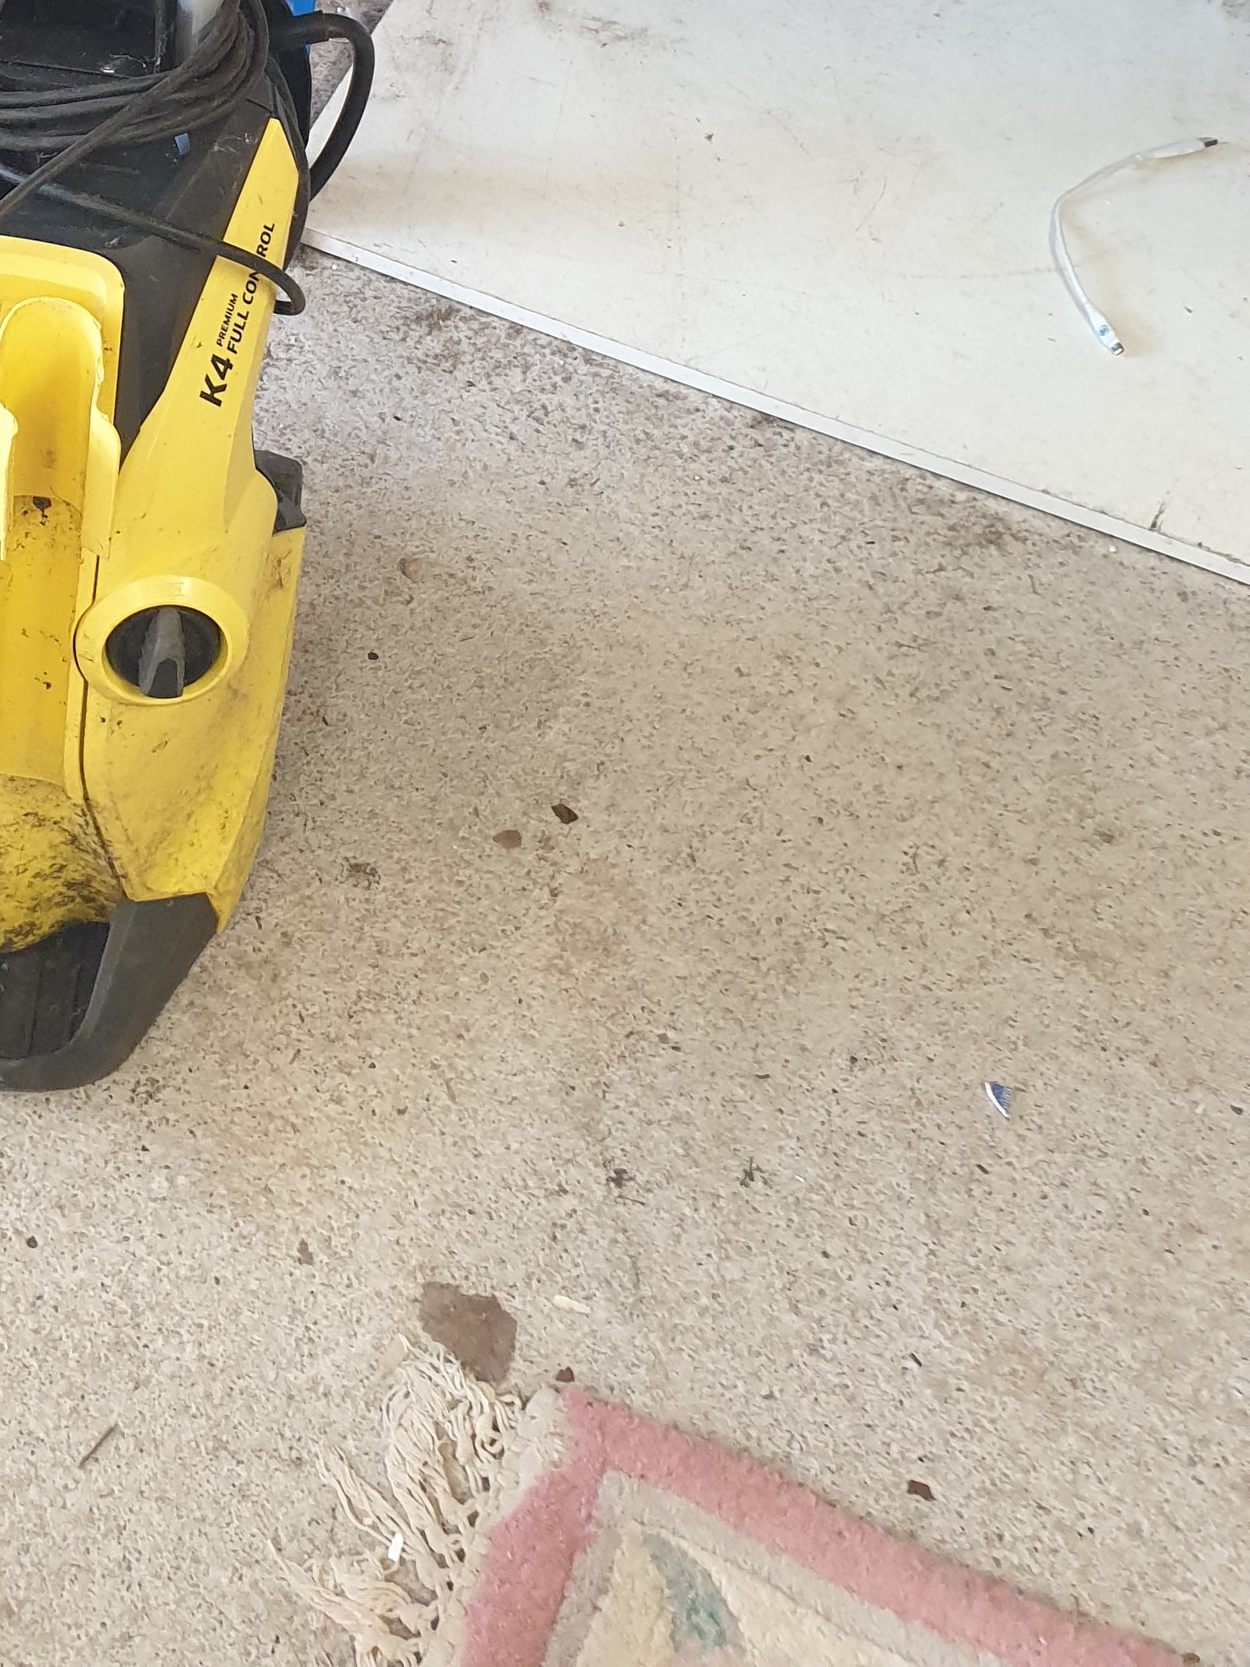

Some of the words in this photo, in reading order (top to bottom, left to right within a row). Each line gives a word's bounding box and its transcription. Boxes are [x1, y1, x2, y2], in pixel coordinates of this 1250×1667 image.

[227, 310, 250, 354] FULL
[242, 222, 275, 305] CONROL
[216, 293, 238, 347] PREMIUM
[199, 353, 234, 408] K4
